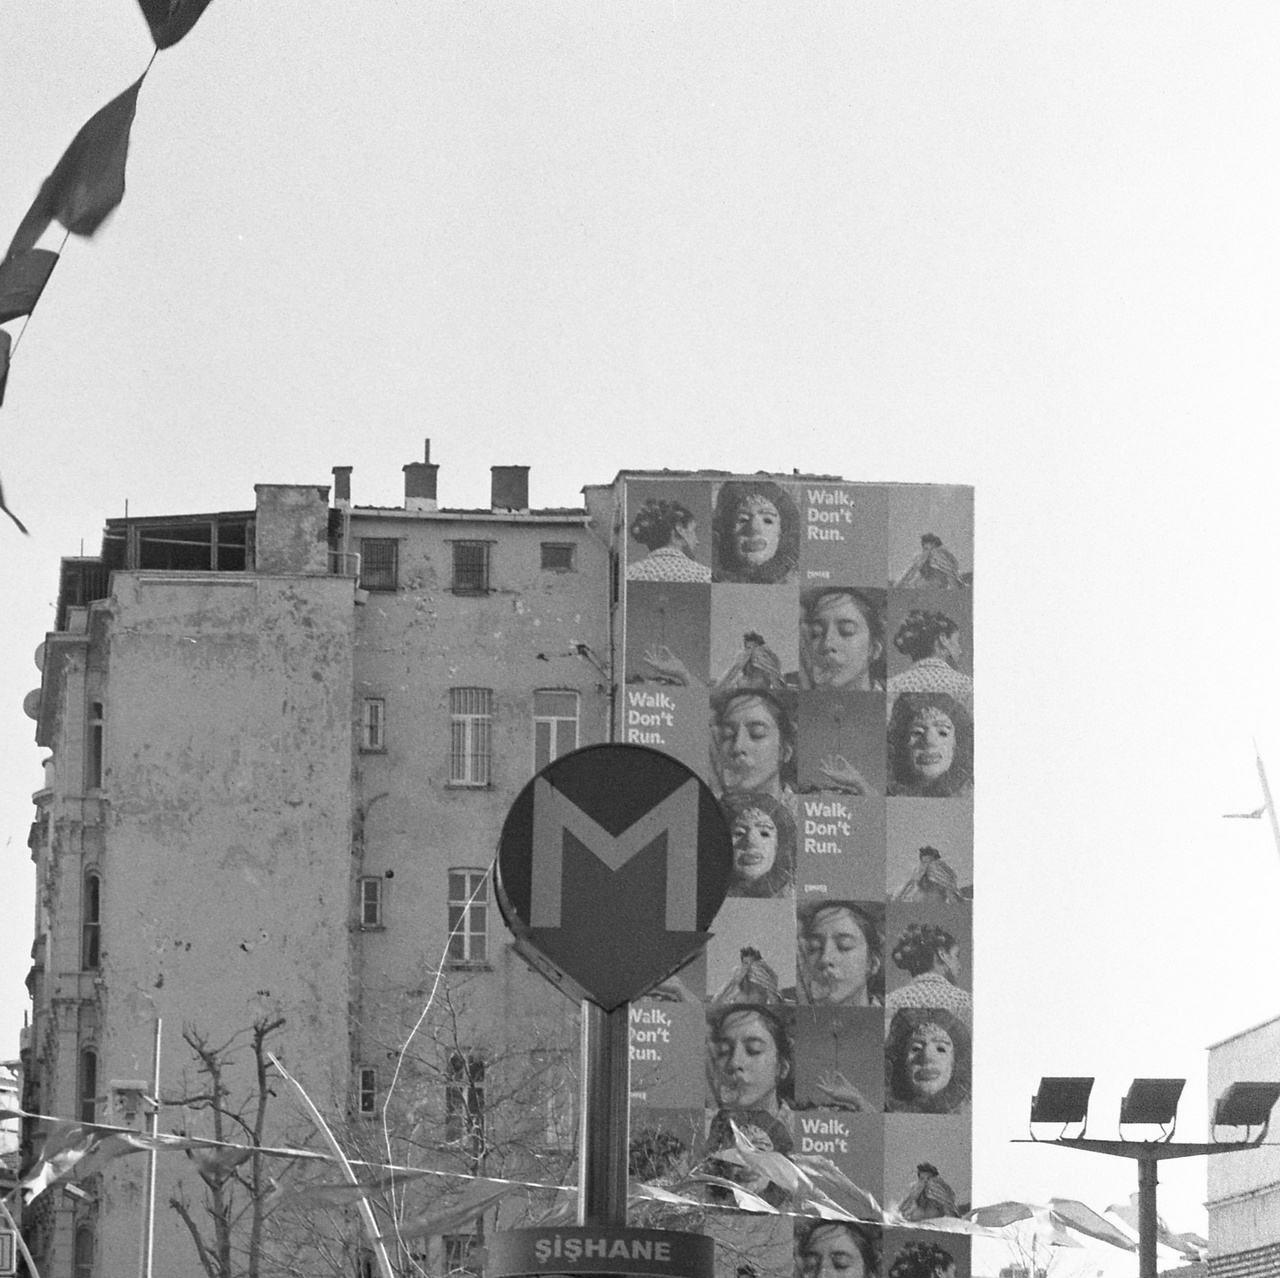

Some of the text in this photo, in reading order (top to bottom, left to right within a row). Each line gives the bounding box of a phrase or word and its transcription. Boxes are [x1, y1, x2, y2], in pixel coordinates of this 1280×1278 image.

[807, 489, 855, 507] Walk,
[807, 508, 853, 524] Don't
[807, 526, 845, 541] Run.
[628, 692, 676, 711] Walk,
[628, 711, 674, 727] Don't
[628, 729, 665, 744] Run.
[805, 801, 853, 819] Walk,
[805, 820, 850, 836] Don't
[530, 775, 699, 931] M
[805, 838, 842, 854] Run.
[801, 1119, 849, 1137] Walk,
[801, 1137, 848, 1153] Don't
[535, 1234, 671, 1263] ŞİŞHANE
